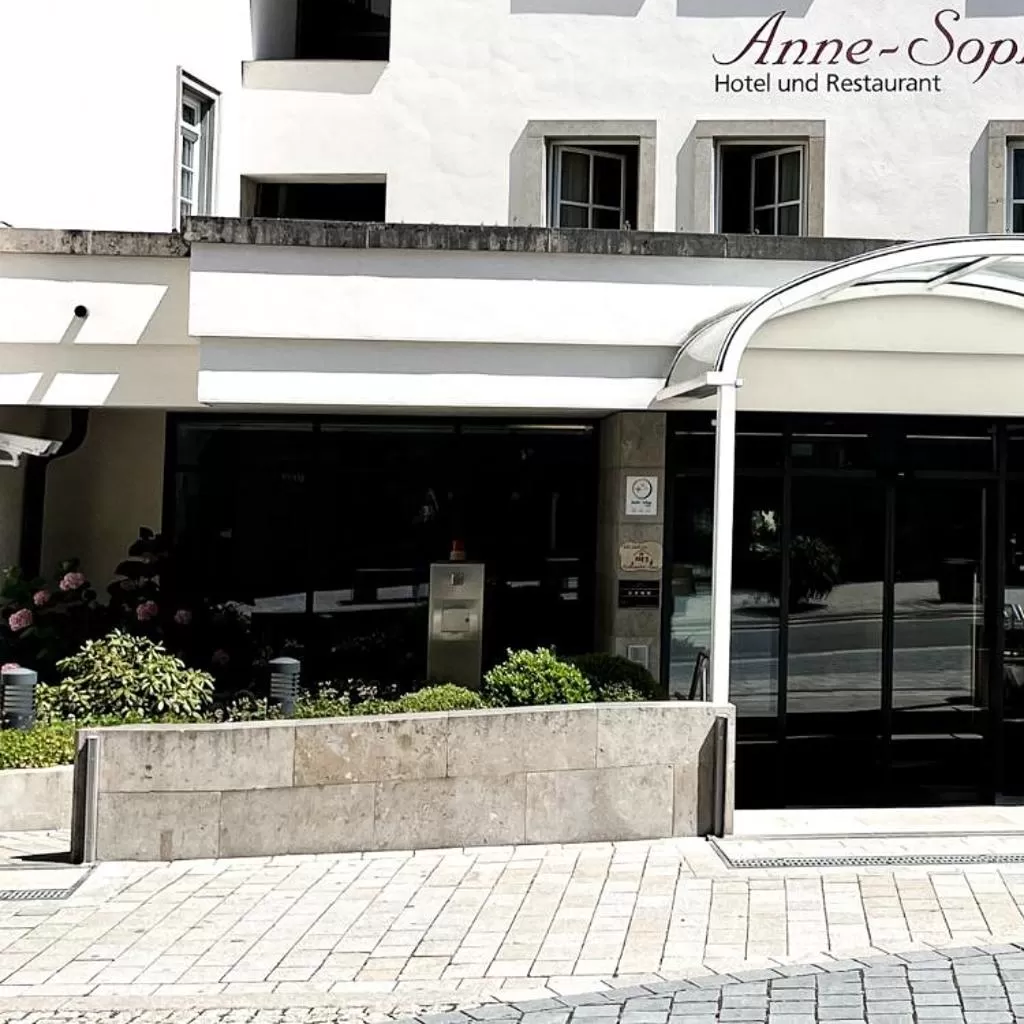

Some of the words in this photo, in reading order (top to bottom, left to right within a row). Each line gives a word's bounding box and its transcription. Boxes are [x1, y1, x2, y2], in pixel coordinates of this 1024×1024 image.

[715, 73, 771, 93] Hotel
[778, 73, 819, 93] und
[827, 74, 942, 93] Restaurant
